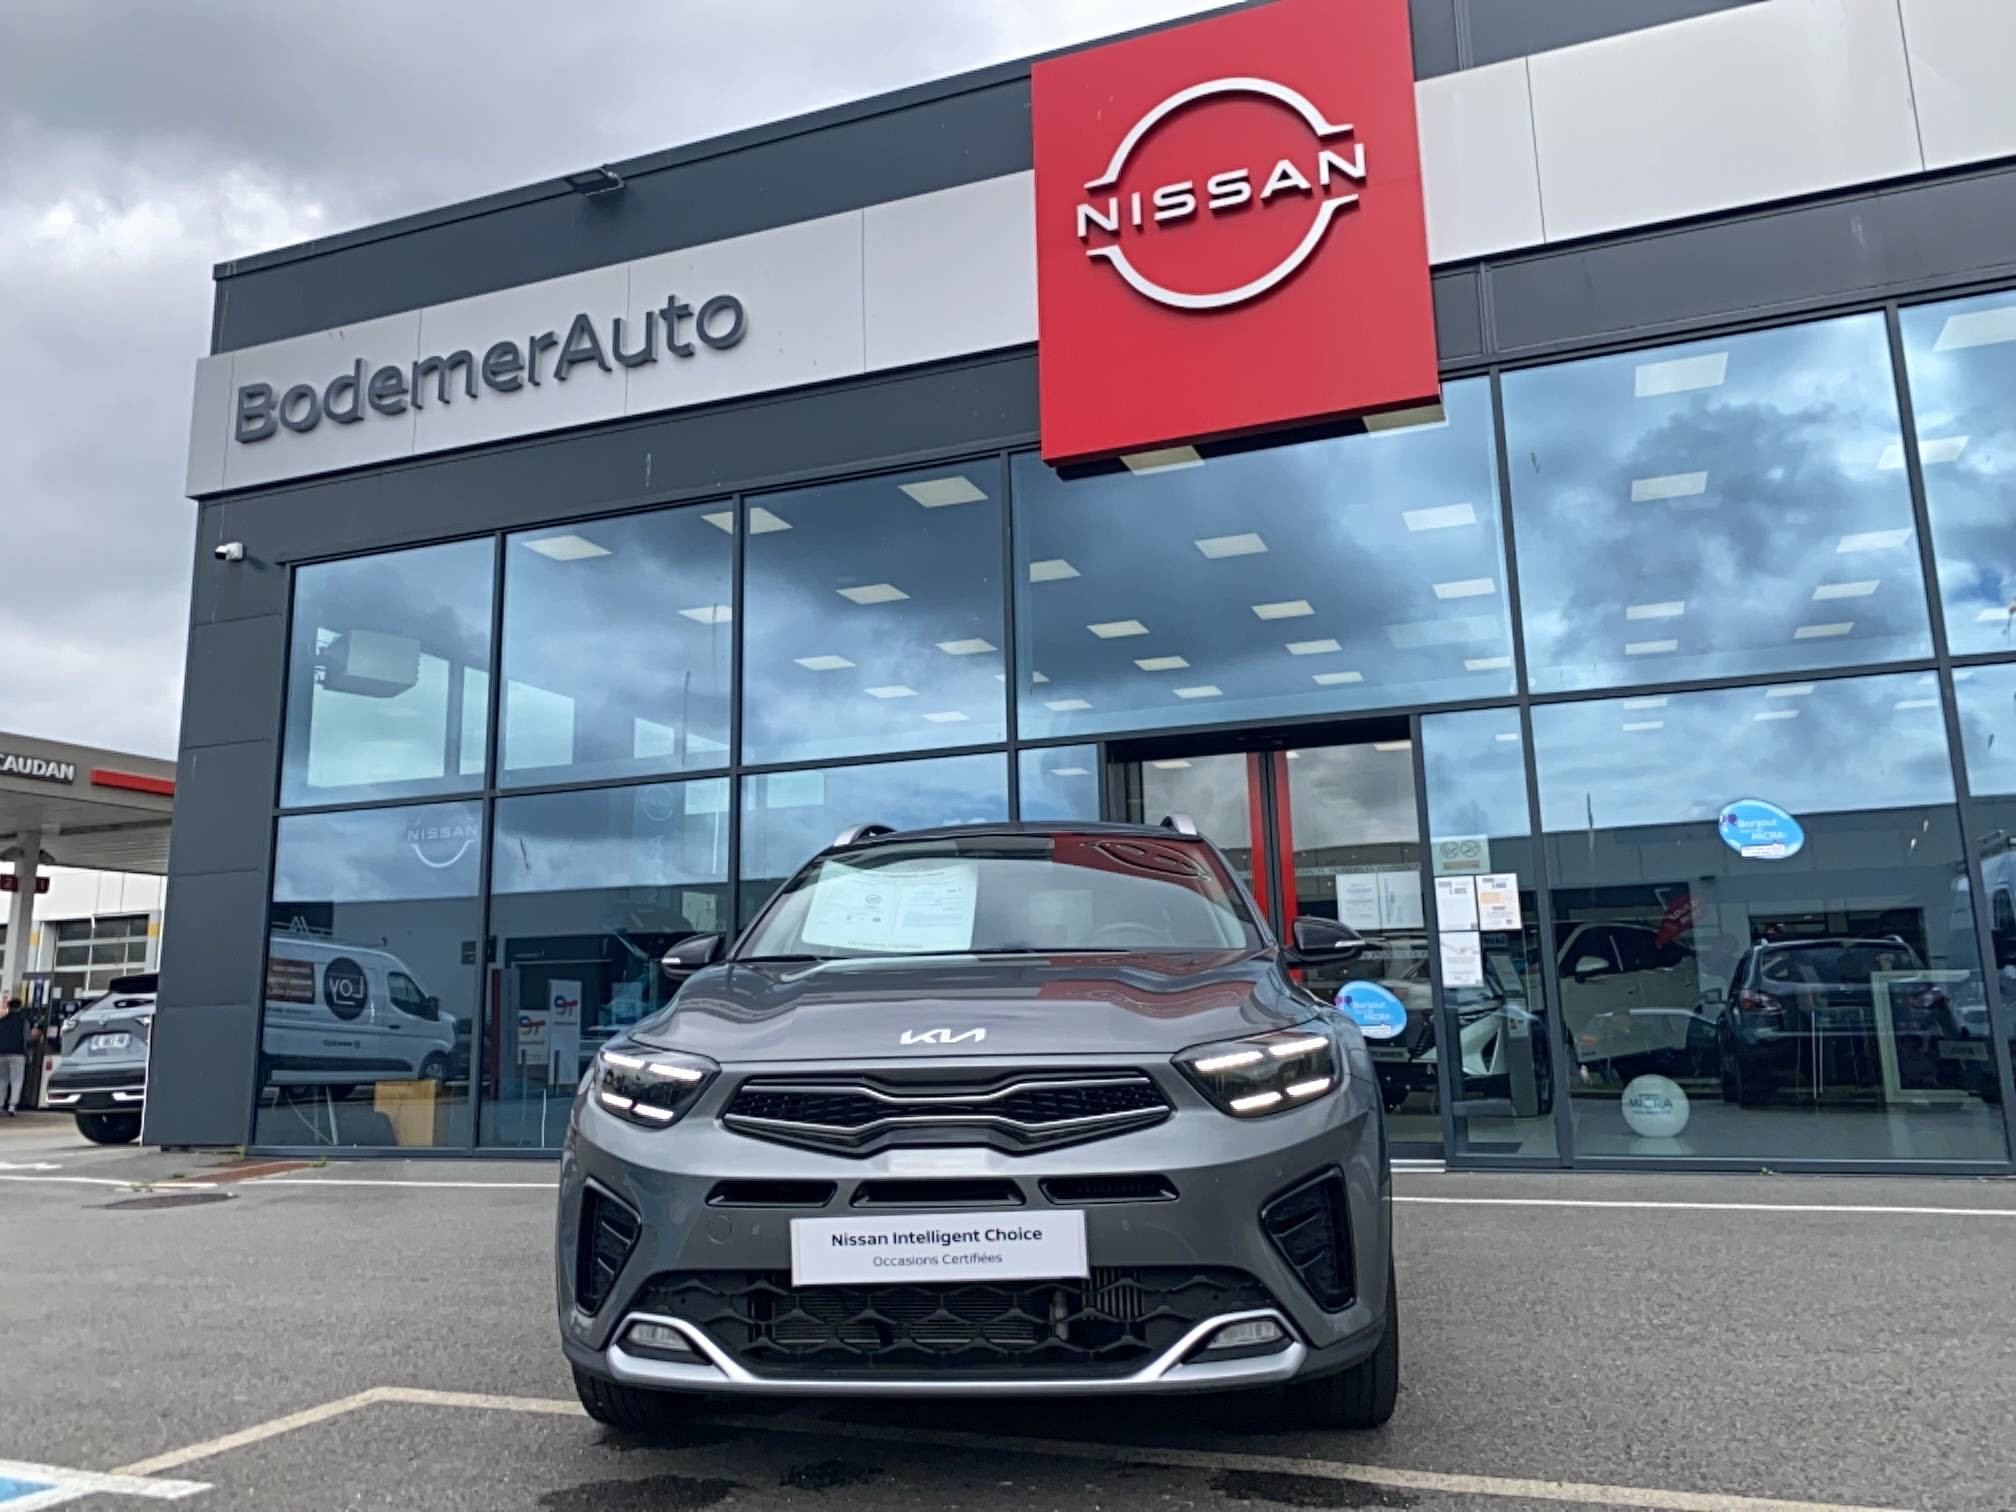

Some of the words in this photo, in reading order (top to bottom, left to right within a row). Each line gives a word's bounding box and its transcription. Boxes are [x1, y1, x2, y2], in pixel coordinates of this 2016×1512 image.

[1077, 143, 1366, 238] NISSAN
[235, 294, 747, 443] BodemerAuto
[408, 824, 478, 841] NISSAN
[900, 1028, 986, 1044] KIA
[832, 1231, 889, 1247] Nissan
[893, 1229, 980, 1246] Intelligent
[985, 1227, 1043, 1242] Choice
[872, 1254, 939, 1267] Occasions
[942, 1252, 1003, 1266] Certifiées
